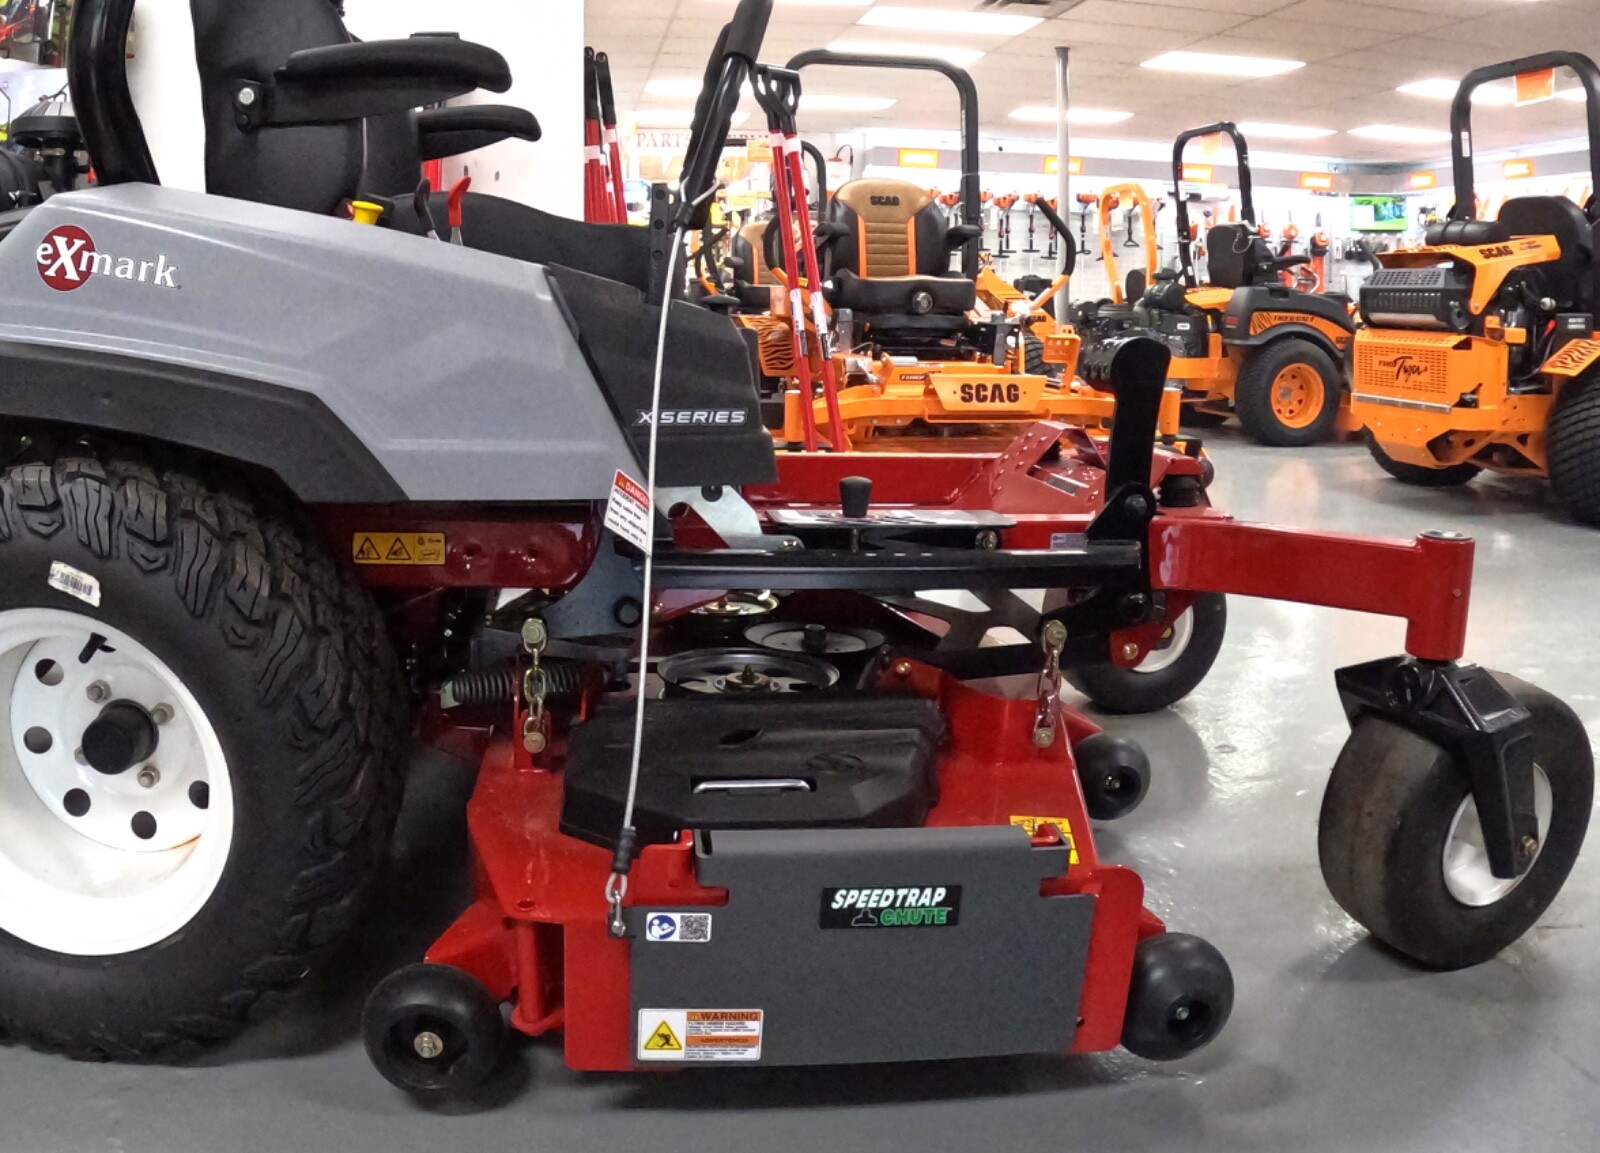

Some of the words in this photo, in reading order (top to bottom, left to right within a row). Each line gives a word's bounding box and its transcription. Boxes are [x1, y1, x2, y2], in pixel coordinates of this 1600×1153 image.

[1478, 245, 1514, 259] SCAG
[960, 383, 1020, 403] SCAG
[660, 411, 745, 423] SERIES
[831, 887, 946, 909] SPEEDTRAP
[880, 907, 947, 926] CHUTE
[700, 1011, 758, 1021] WARNING
